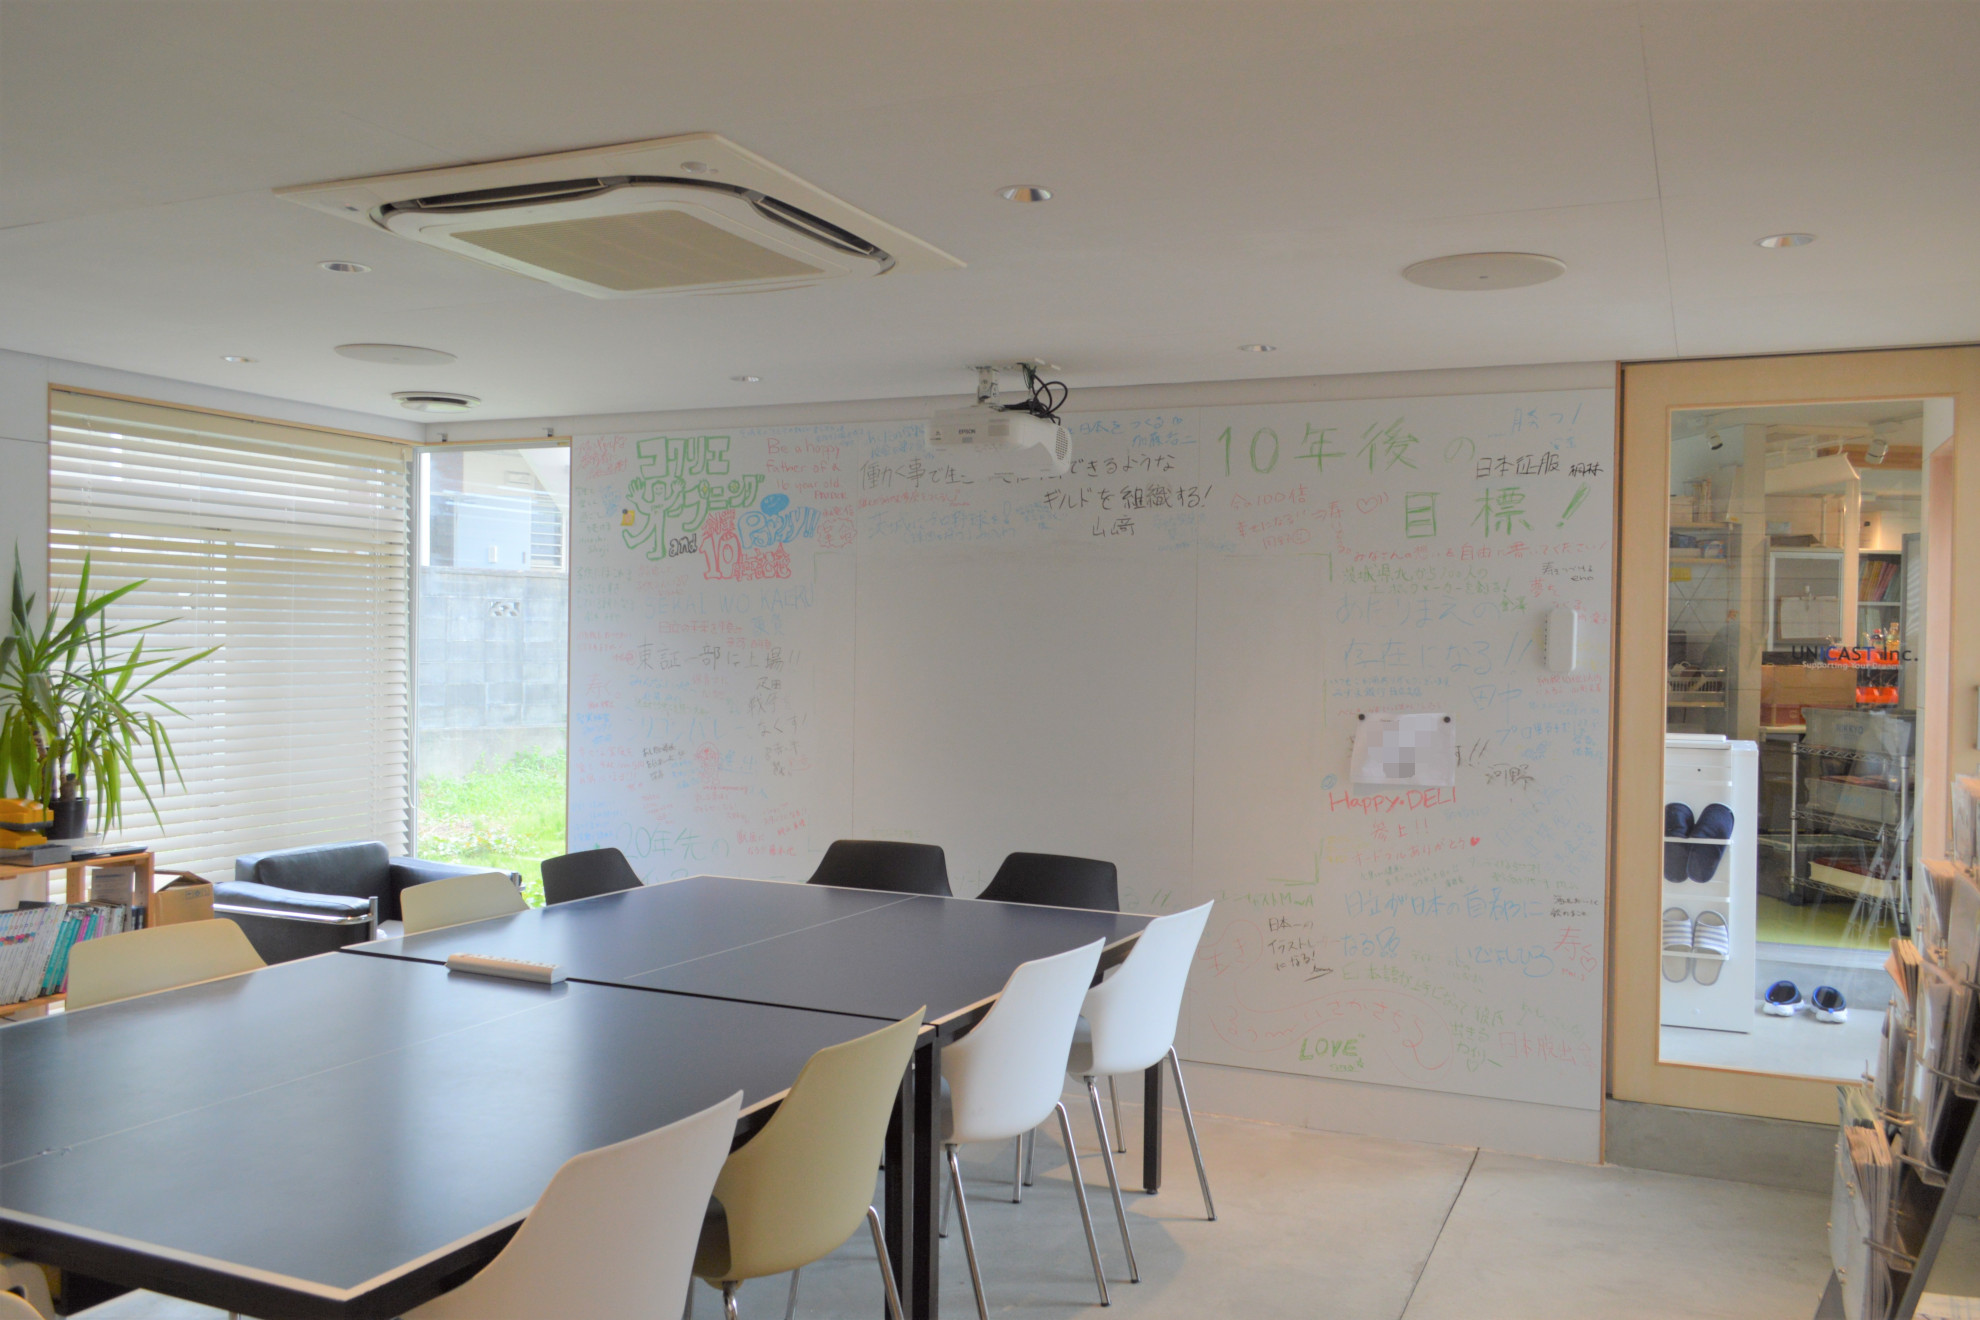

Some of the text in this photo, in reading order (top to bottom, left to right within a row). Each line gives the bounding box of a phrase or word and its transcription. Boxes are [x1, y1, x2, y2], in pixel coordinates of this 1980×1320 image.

[767, 437, 788, 455] Be
[1217, 416, 1477, 477] 10年後の
[1043, 484, 1213, 511] ギルドを組織する!
[1404, 482, 1591, 539] 目標!
[668, 533, 698, 557] and
[1791, 645, 1919, 662] UNICAST Inc.
[1298, 1036, 1360, 1062] LOVE
